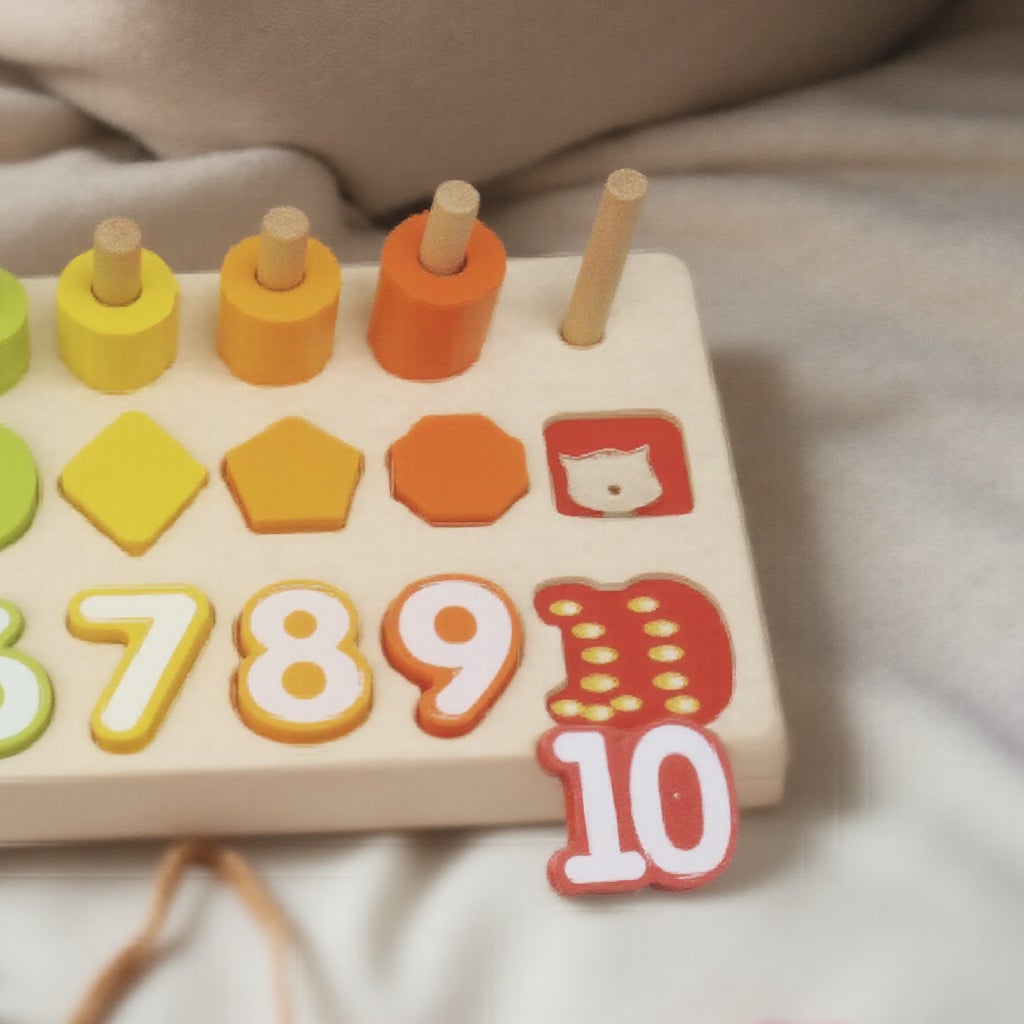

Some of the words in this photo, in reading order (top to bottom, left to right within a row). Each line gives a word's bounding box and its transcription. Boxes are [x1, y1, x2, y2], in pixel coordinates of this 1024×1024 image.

[77, 592, 200, 734] 7
[246, 587, 366, 725] 8
[396, 578, 515, 718] 9
[552, 722, 734, 885] 10
